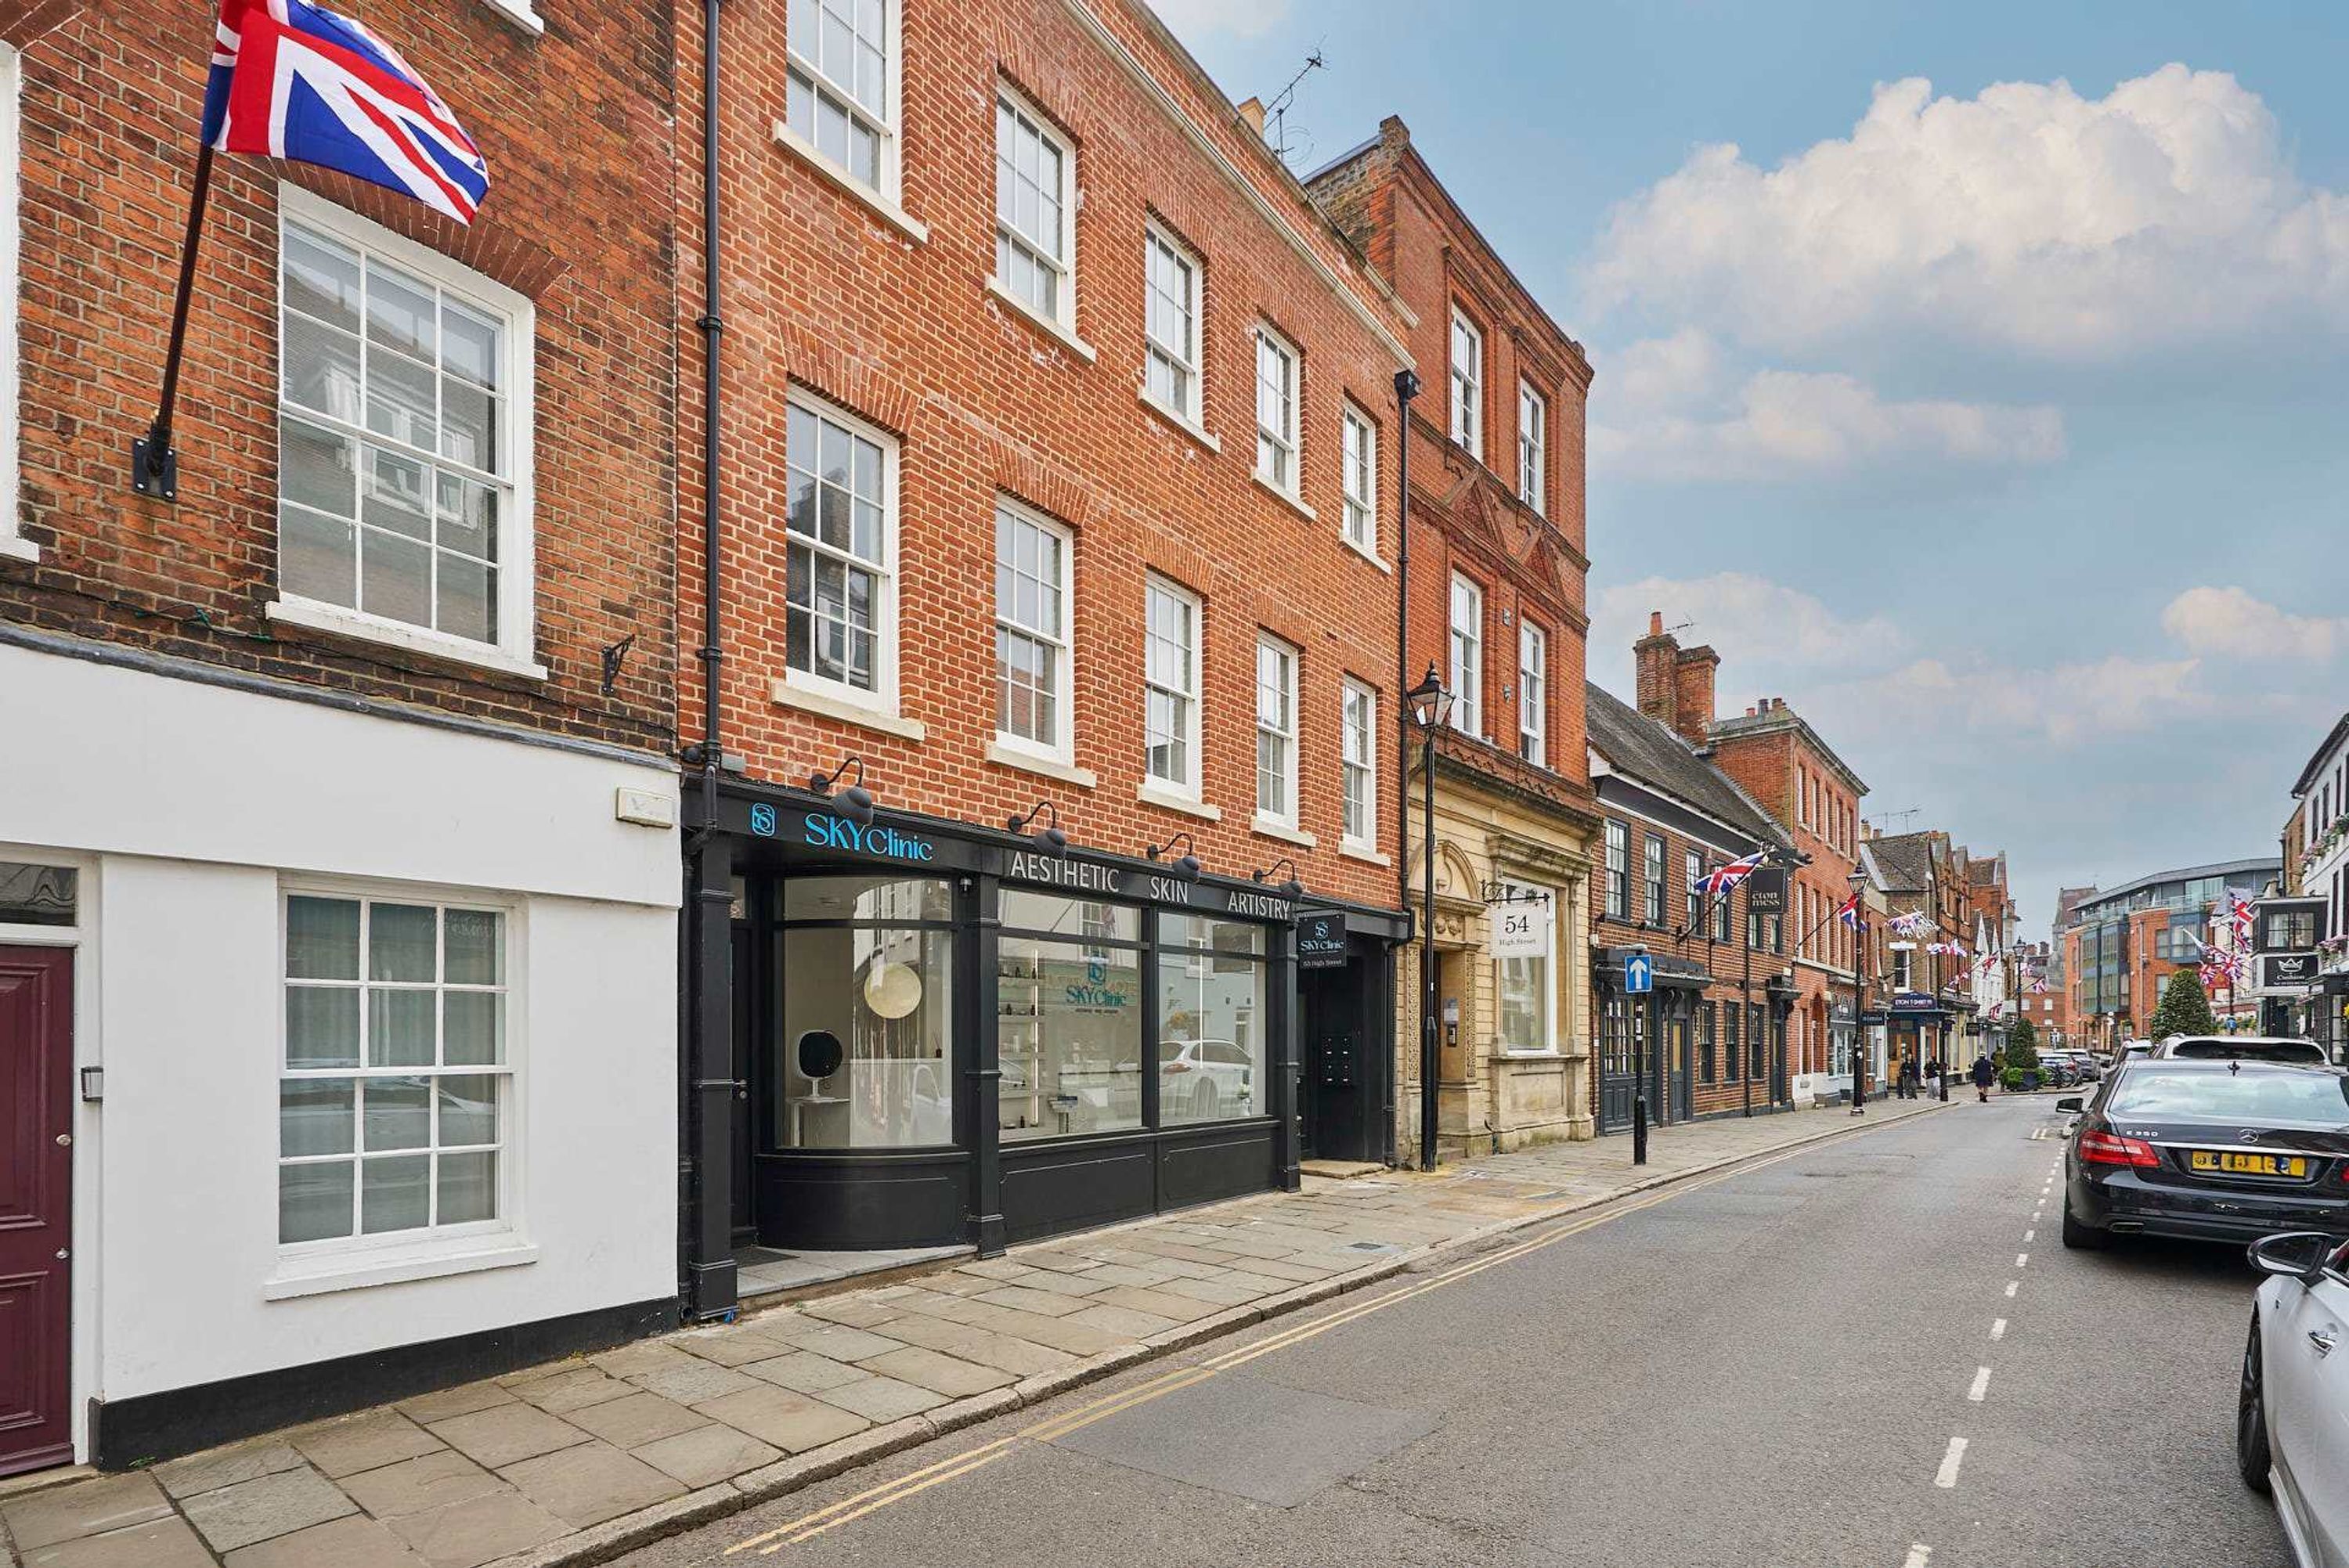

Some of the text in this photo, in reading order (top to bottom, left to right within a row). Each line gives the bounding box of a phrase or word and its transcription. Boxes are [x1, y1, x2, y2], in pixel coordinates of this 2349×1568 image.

[805, 813, 933, 861] SKYClinic
[1010, 851, 1290, 920] AESTHETIC SKIN ARTISTRY
[1752, 891, 1777, 900] eton
[1505, 914, 1529, 935] 54
[1066, 985, 1128, 1008] SKYClinic
